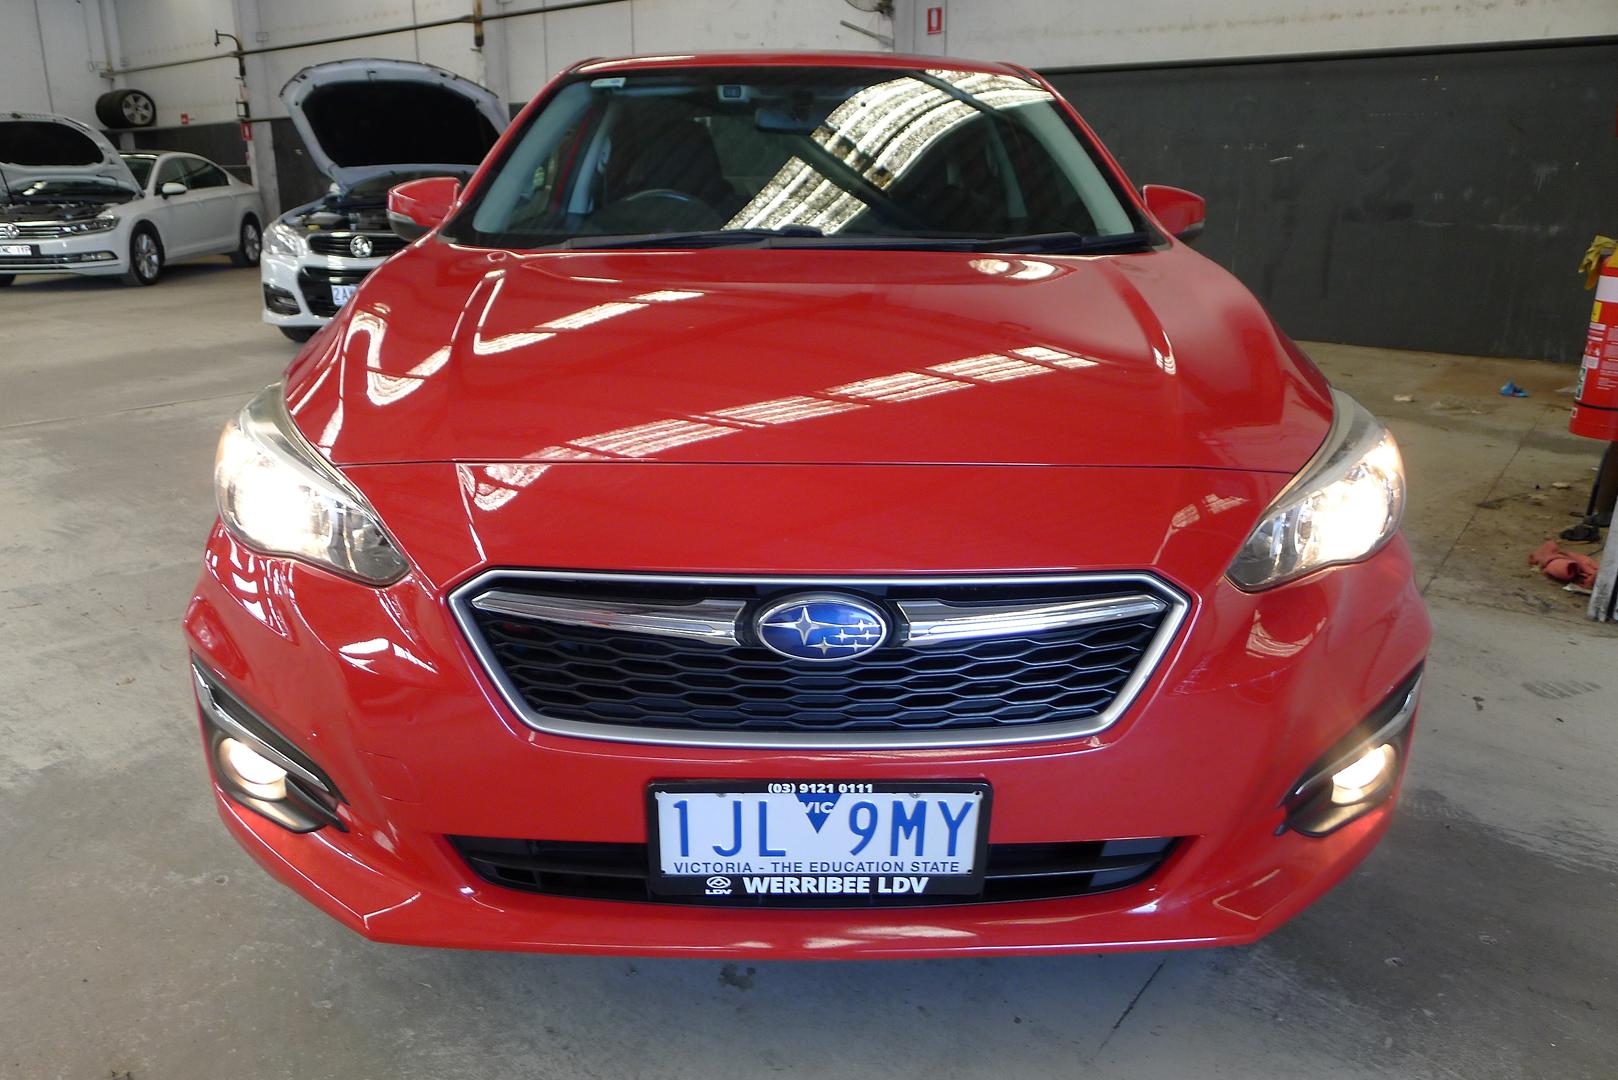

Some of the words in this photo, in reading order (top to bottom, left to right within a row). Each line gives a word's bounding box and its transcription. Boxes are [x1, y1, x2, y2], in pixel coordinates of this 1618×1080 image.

[768, 783, 796, 793] (03)
[799, 783, 834, 793] 9121
[838, 783, 873, 793] 0111
[800, 801, 835, 814] VIC
[673, 800, 786, 857] 1JL
[848, 800, 974, 857] 9MY
[674, 862, 753, 873] VICTORIA
[771, 862, 803, 873] THE
[810, 861, 904, 873] EDUCATION
[910, 861, 960, 872] STATE
[742, 876, 871, 894] WERRIBEE
[878, 876, 930, 894] LDV
